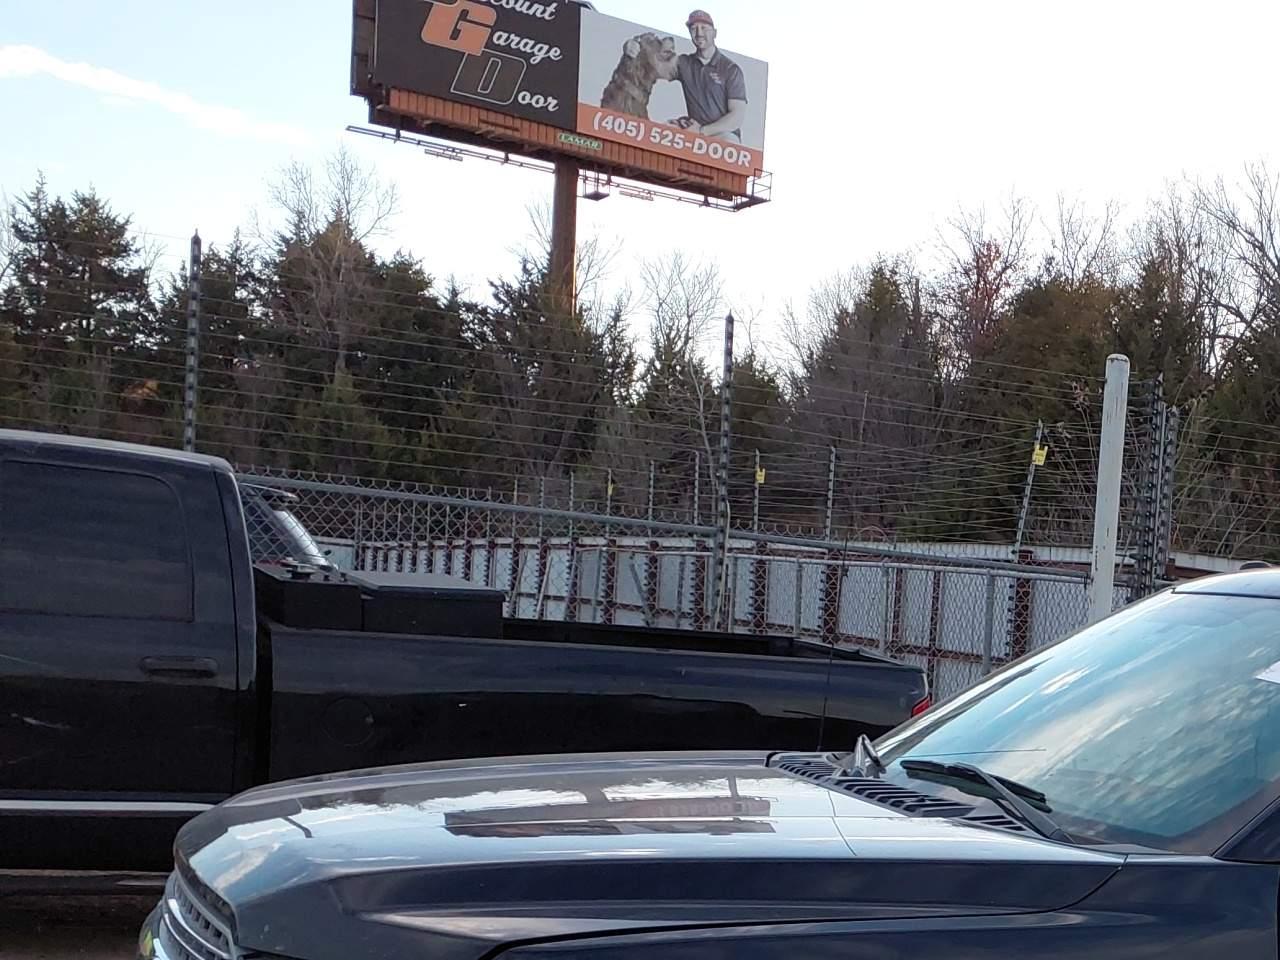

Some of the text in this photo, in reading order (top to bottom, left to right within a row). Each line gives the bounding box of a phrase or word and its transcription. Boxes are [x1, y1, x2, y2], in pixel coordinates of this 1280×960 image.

[421, 0, 562, 64] Garage
[450, 48, 560, 111] Door
[593, 111, 752, 168] (405) 525-DOOR
